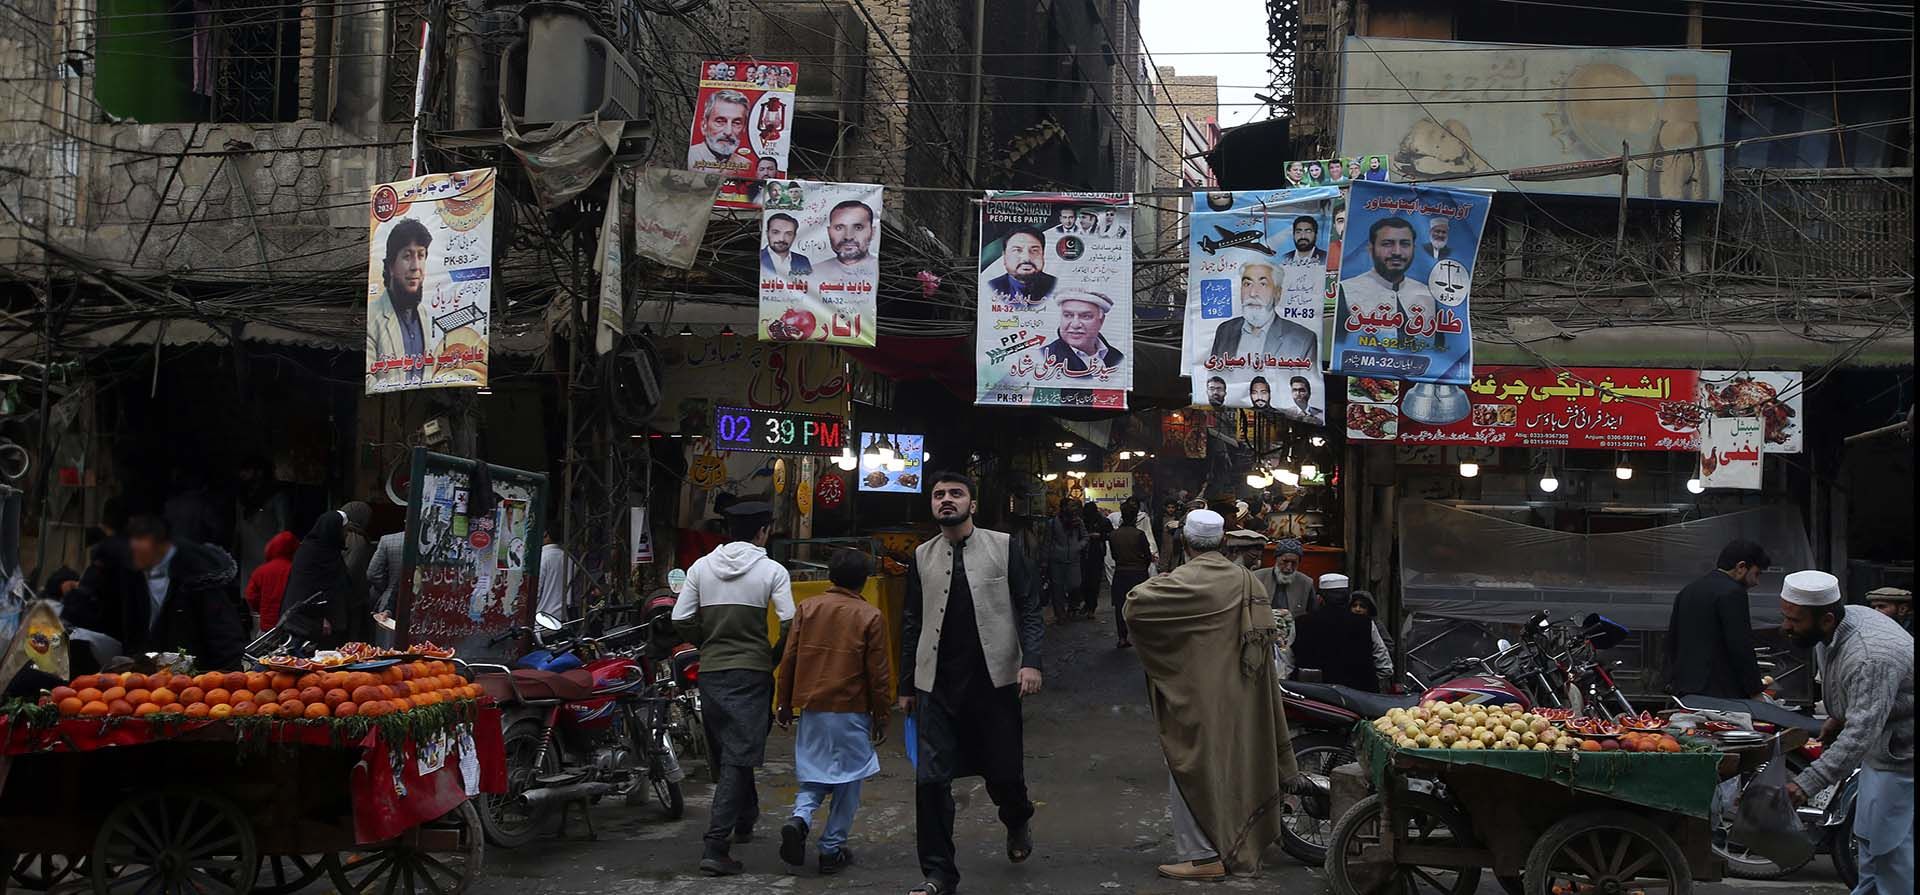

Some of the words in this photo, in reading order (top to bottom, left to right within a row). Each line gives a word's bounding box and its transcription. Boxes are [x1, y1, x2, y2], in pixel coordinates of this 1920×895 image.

[377, 204, 393, 212] 2024
[987, 202, 1051, 215] PAKISTAN
[990, 215, 1023, 224] PEOPLES
[1024, 216, 1048, 224] PARTY
[443, 255, 468, 266] PK-83
[1200, 260, 1216, 274] جہاز
[1217, 255, 1238, 273] ہوائی
[761, 277, 785, 293] جاوید
[847, 280, 872, 295] جاوید
[1439, 293, 1455, 301] ترازو
[992, 304, 1014, 312] NA-32
[1284, 307, 1314, 319] PK-83
[816, 312, 861, 342] انار
[993, 315, 1019, 330] تیر
[1345, 304, 1404, 333] متین
[1405, 305, 1463, 337] طارق
[1000, 330, 1028, 347] PPP
[1359, 336, 1398, 348] NA-32
[1009, 354, 1033, 377] شاہ
[1033, 347, 1056, 380] علی
[1048, 357, 1098, 380] ظاہر
[1253, 352, 1277, 371] طارق
[1279, 355, 1312, 369] محمد
[1361, 356, 1394, 368] NA-32
[748, 352, 847, 411] صافی
[1097, 365, 1118, 382] سید
[1470, 374, 1530, 404] چرغہ
[1531, 371, 1595, 402] دیگی
[1600, 375, 1671, 403] الشیخ
[997, 394, 1023, 402] PK-83
[720, 415, 751, 443] 02
[766, 418, 795, 445] 39
[803, 420, 840, 447] PM
[1731, 419, 1760, 437] سپیشل
[1719, 440, 1759, 466] یخنی
